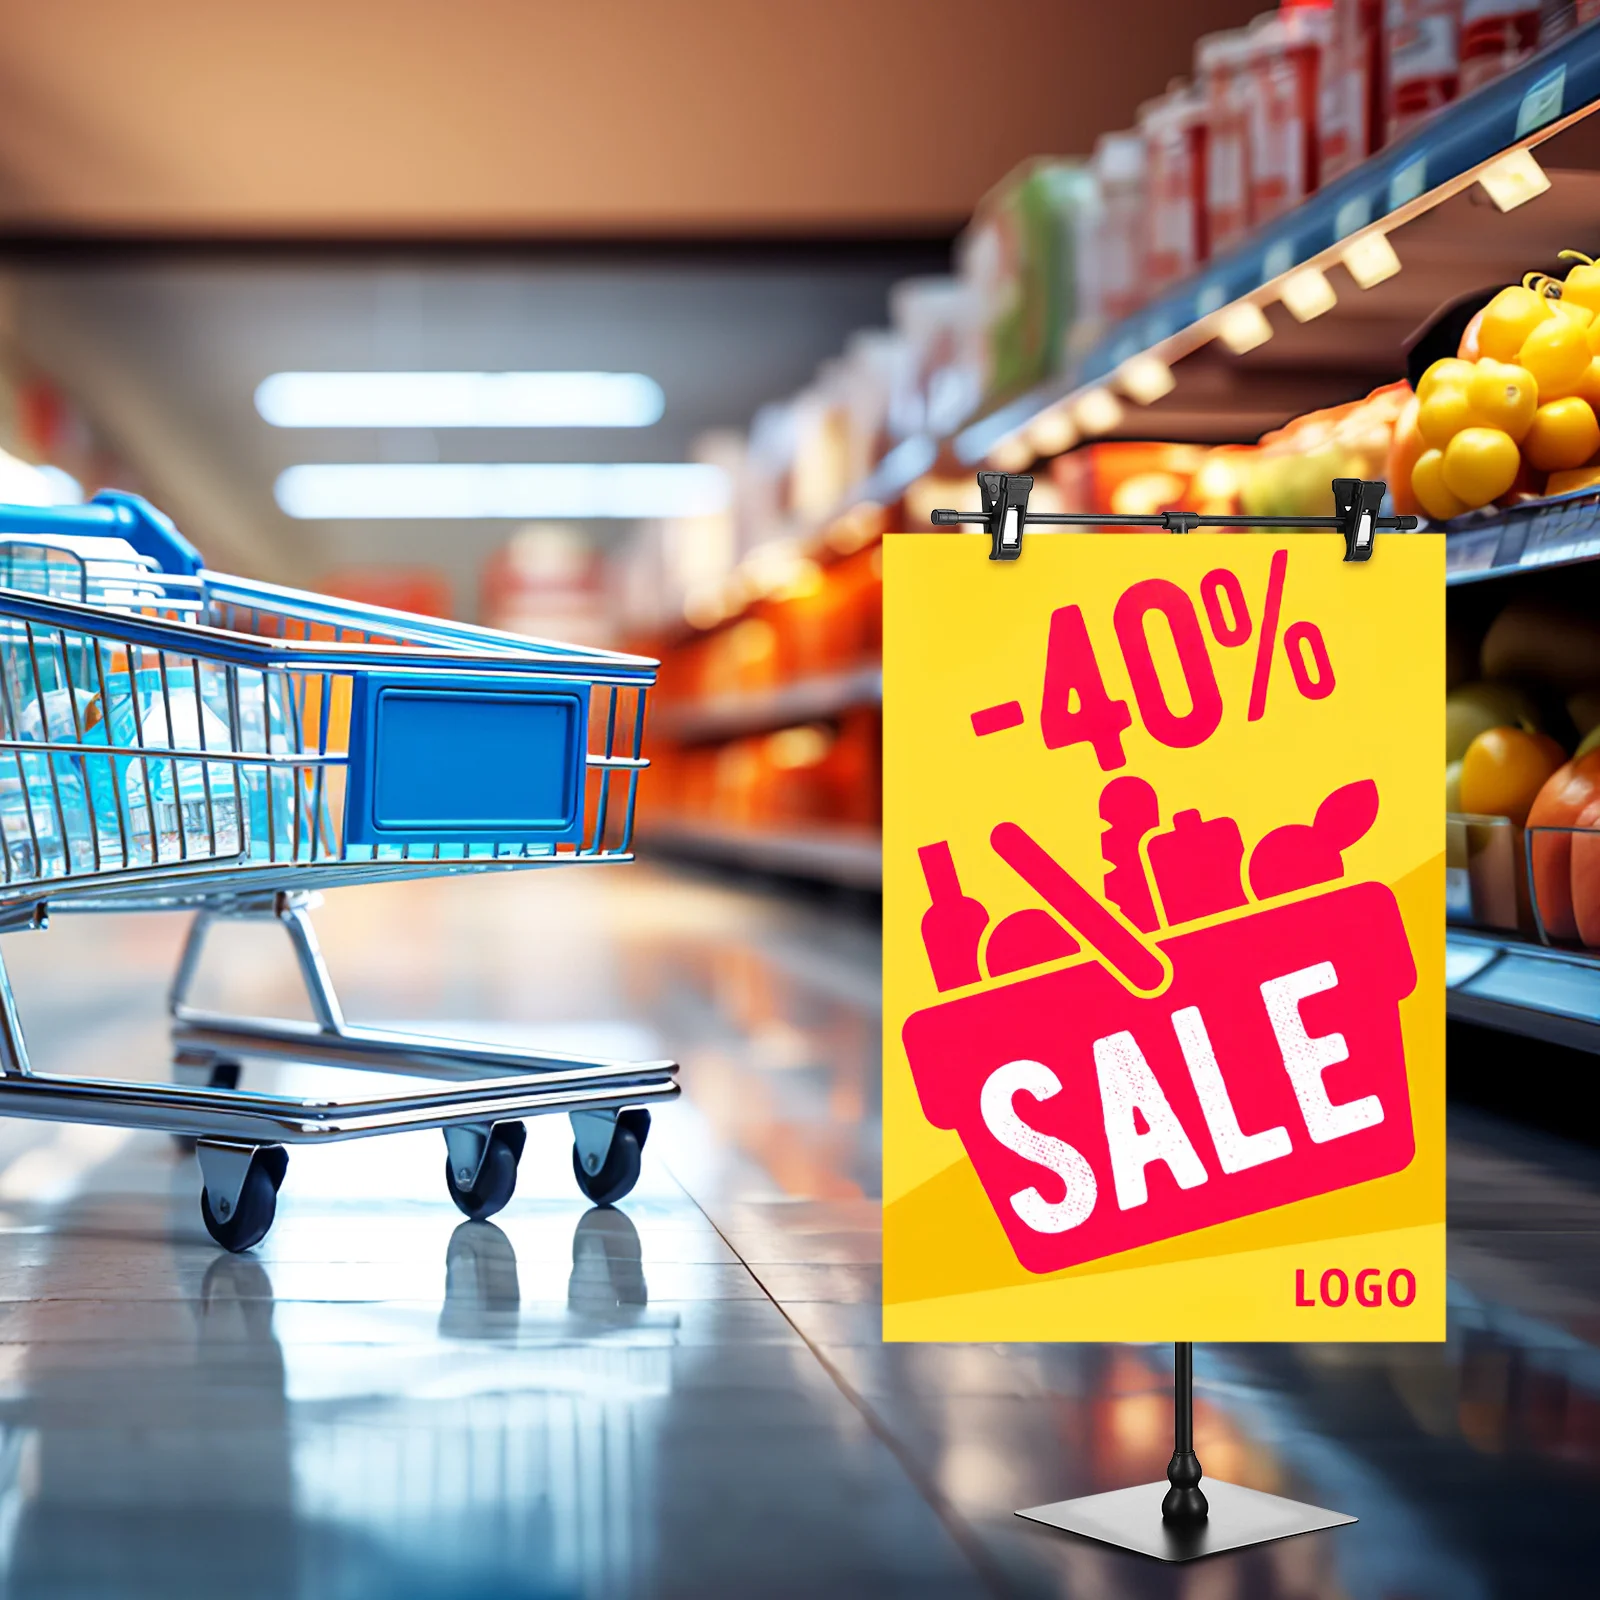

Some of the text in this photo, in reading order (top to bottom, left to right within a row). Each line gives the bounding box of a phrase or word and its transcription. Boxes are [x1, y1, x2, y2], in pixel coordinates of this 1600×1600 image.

[971, 550, 1335, 771] -40%
[980, 961, 1385, 1234] SALE
[1295, 1268, 1417, 1308] LOGO
